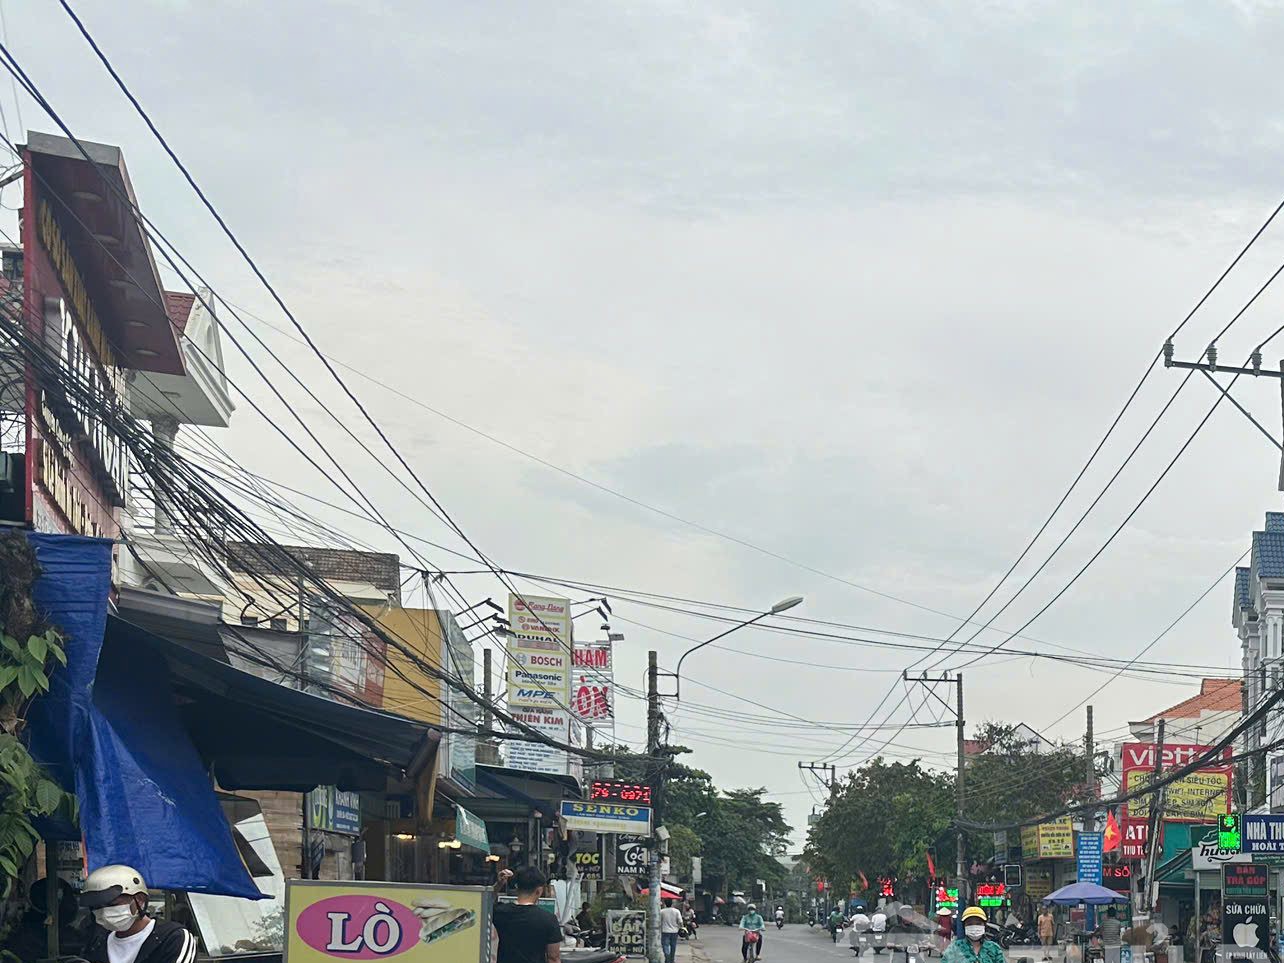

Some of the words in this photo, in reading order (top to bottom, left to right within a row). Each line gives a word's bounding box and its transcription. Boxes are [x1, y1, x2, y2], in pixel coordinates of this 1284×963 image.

[530, 655, 563, 667] BOSCH
[515, 671, 562, 681] Panasonic
[517, 688, 556, 699] MPE
[544, 715, 563, 725] KIM
[572, 803, 639, 817] SENKO
[1246, 818, 1267, 841] NHÀ
[617, 866, 638, 874] NAM
[325, 900, 404, 954] LÒ
